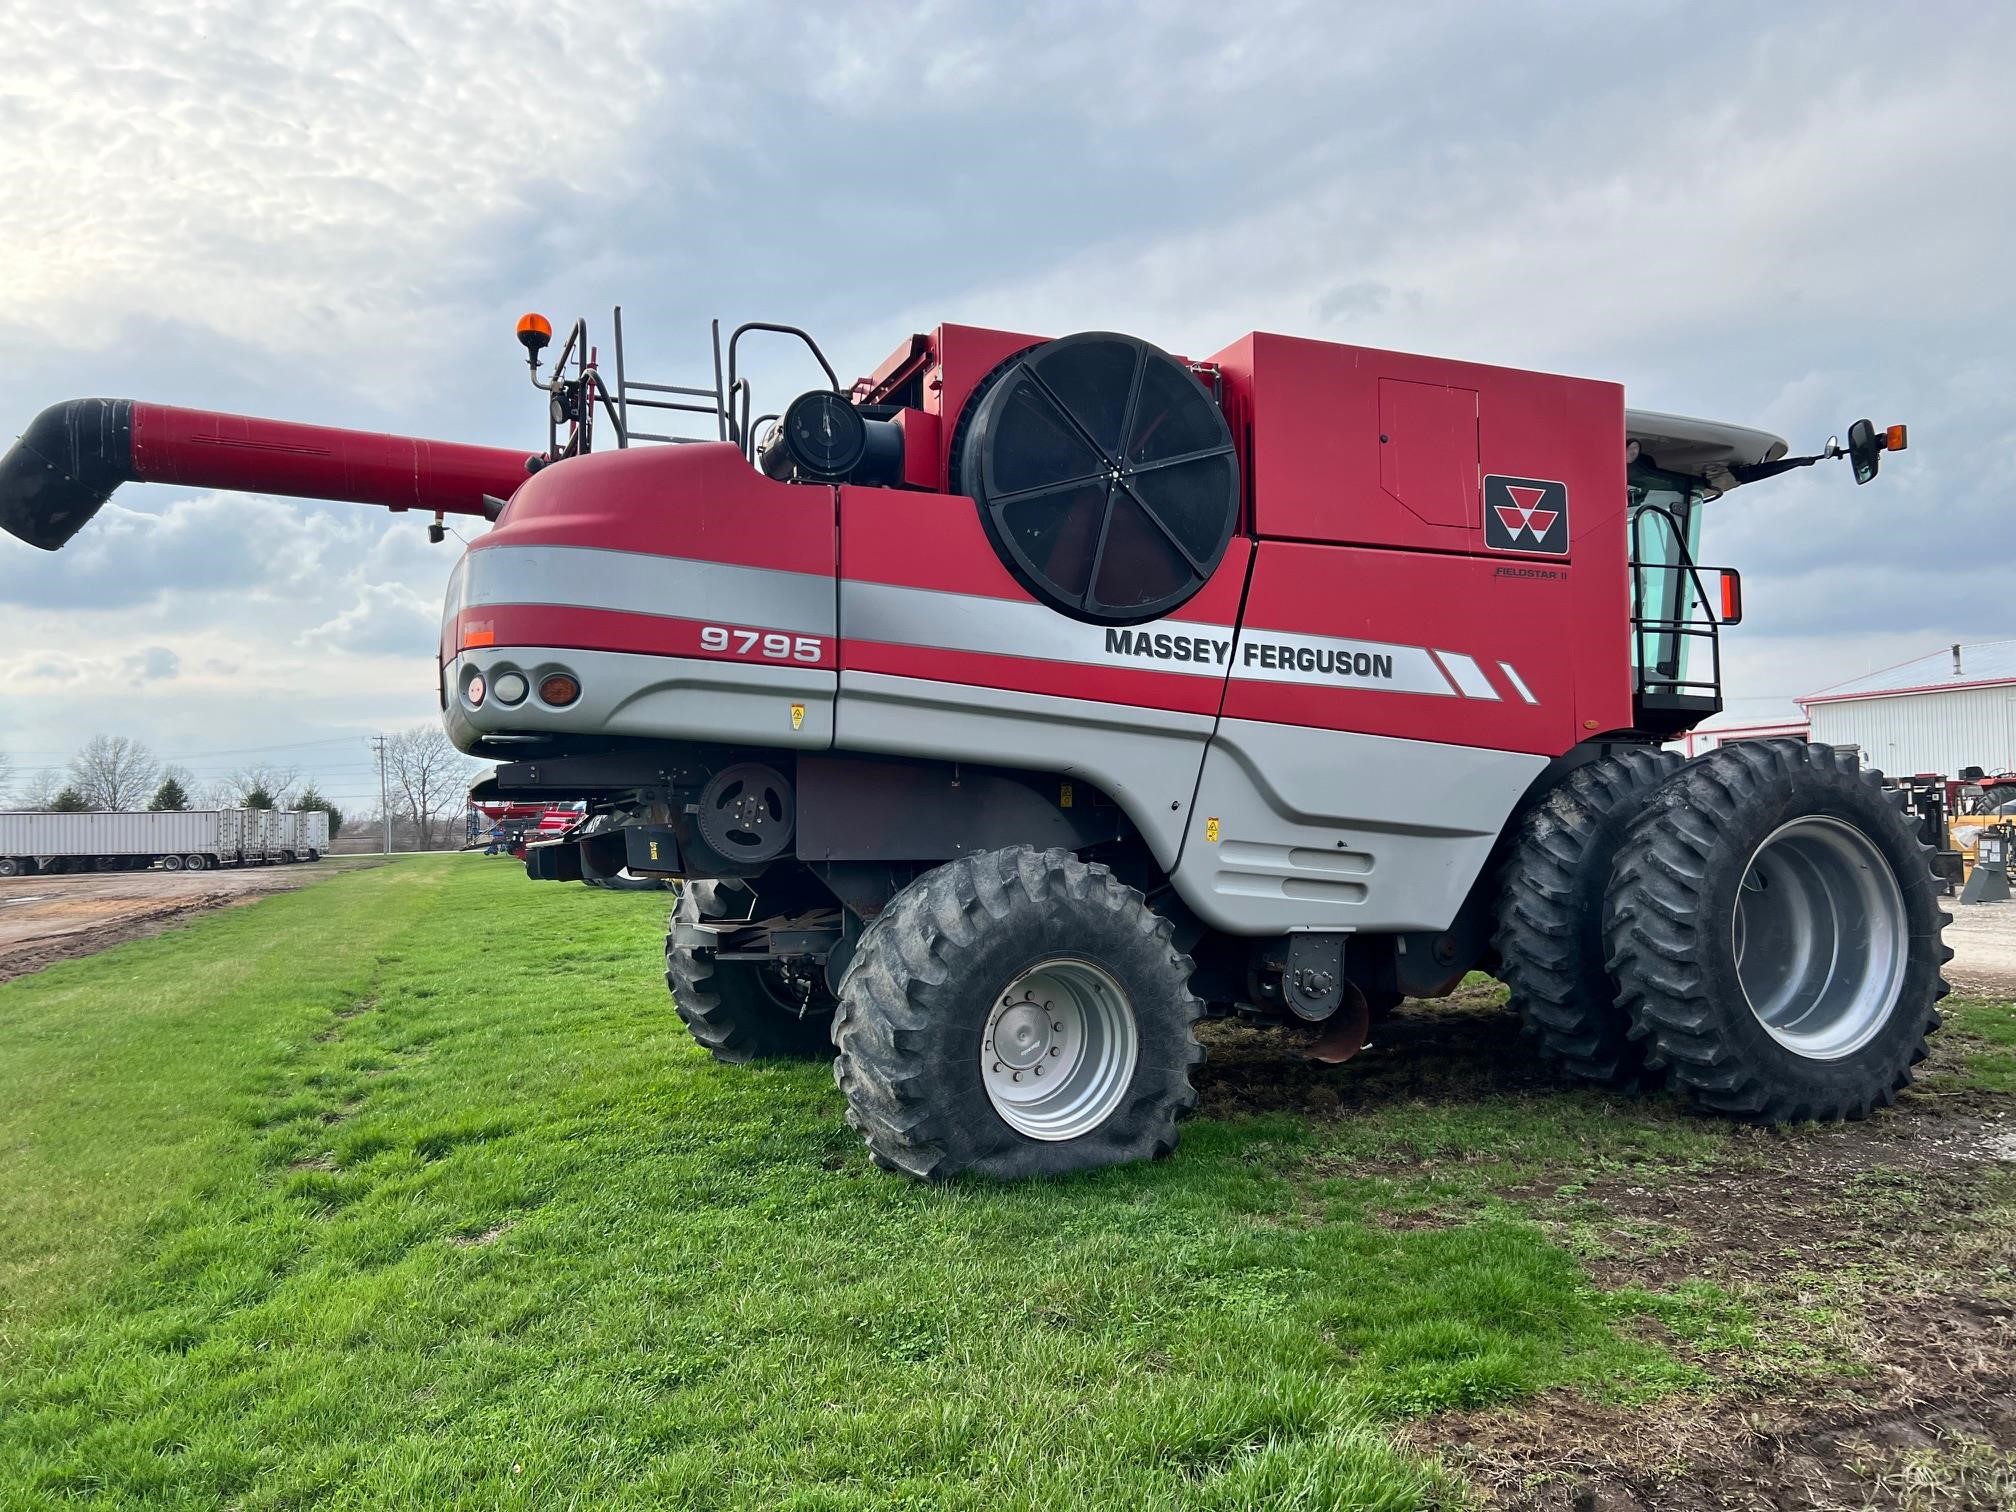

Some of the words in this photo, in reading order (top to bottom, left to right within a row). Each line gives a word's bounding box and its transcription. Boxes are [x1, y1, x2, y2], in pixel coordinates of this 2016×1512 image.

[1496, 567, 1557, 579] FIELDSTAR
[700, 626, 822, 662] 9795
[1105, 628, 1231, 665] MASSEY
[1243, 643, 1393, 679] FERGUSON
